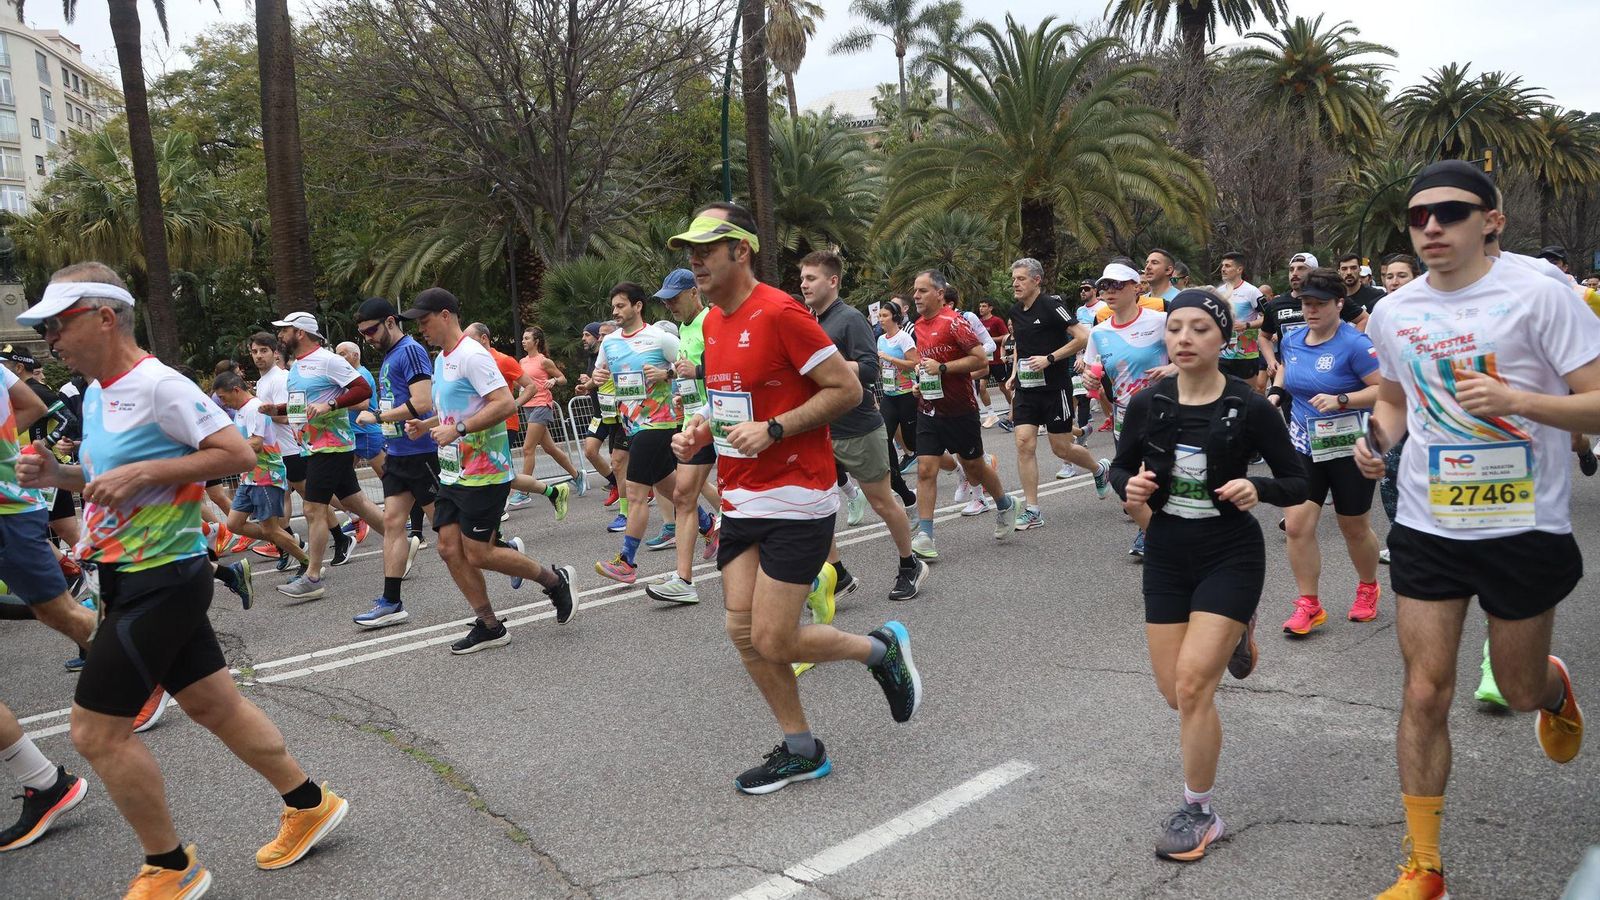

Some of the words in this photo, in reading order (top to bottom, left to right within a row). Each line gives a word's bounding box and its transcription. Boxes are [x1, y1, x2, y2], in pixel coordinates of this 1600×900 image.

[1416, 333, 1475, 354] SILVESTRE
[621, 386, 640, 395] 4454
[1322, 433, 1356, 449] 5638
[1449, 483, 1516, 506] 2746
